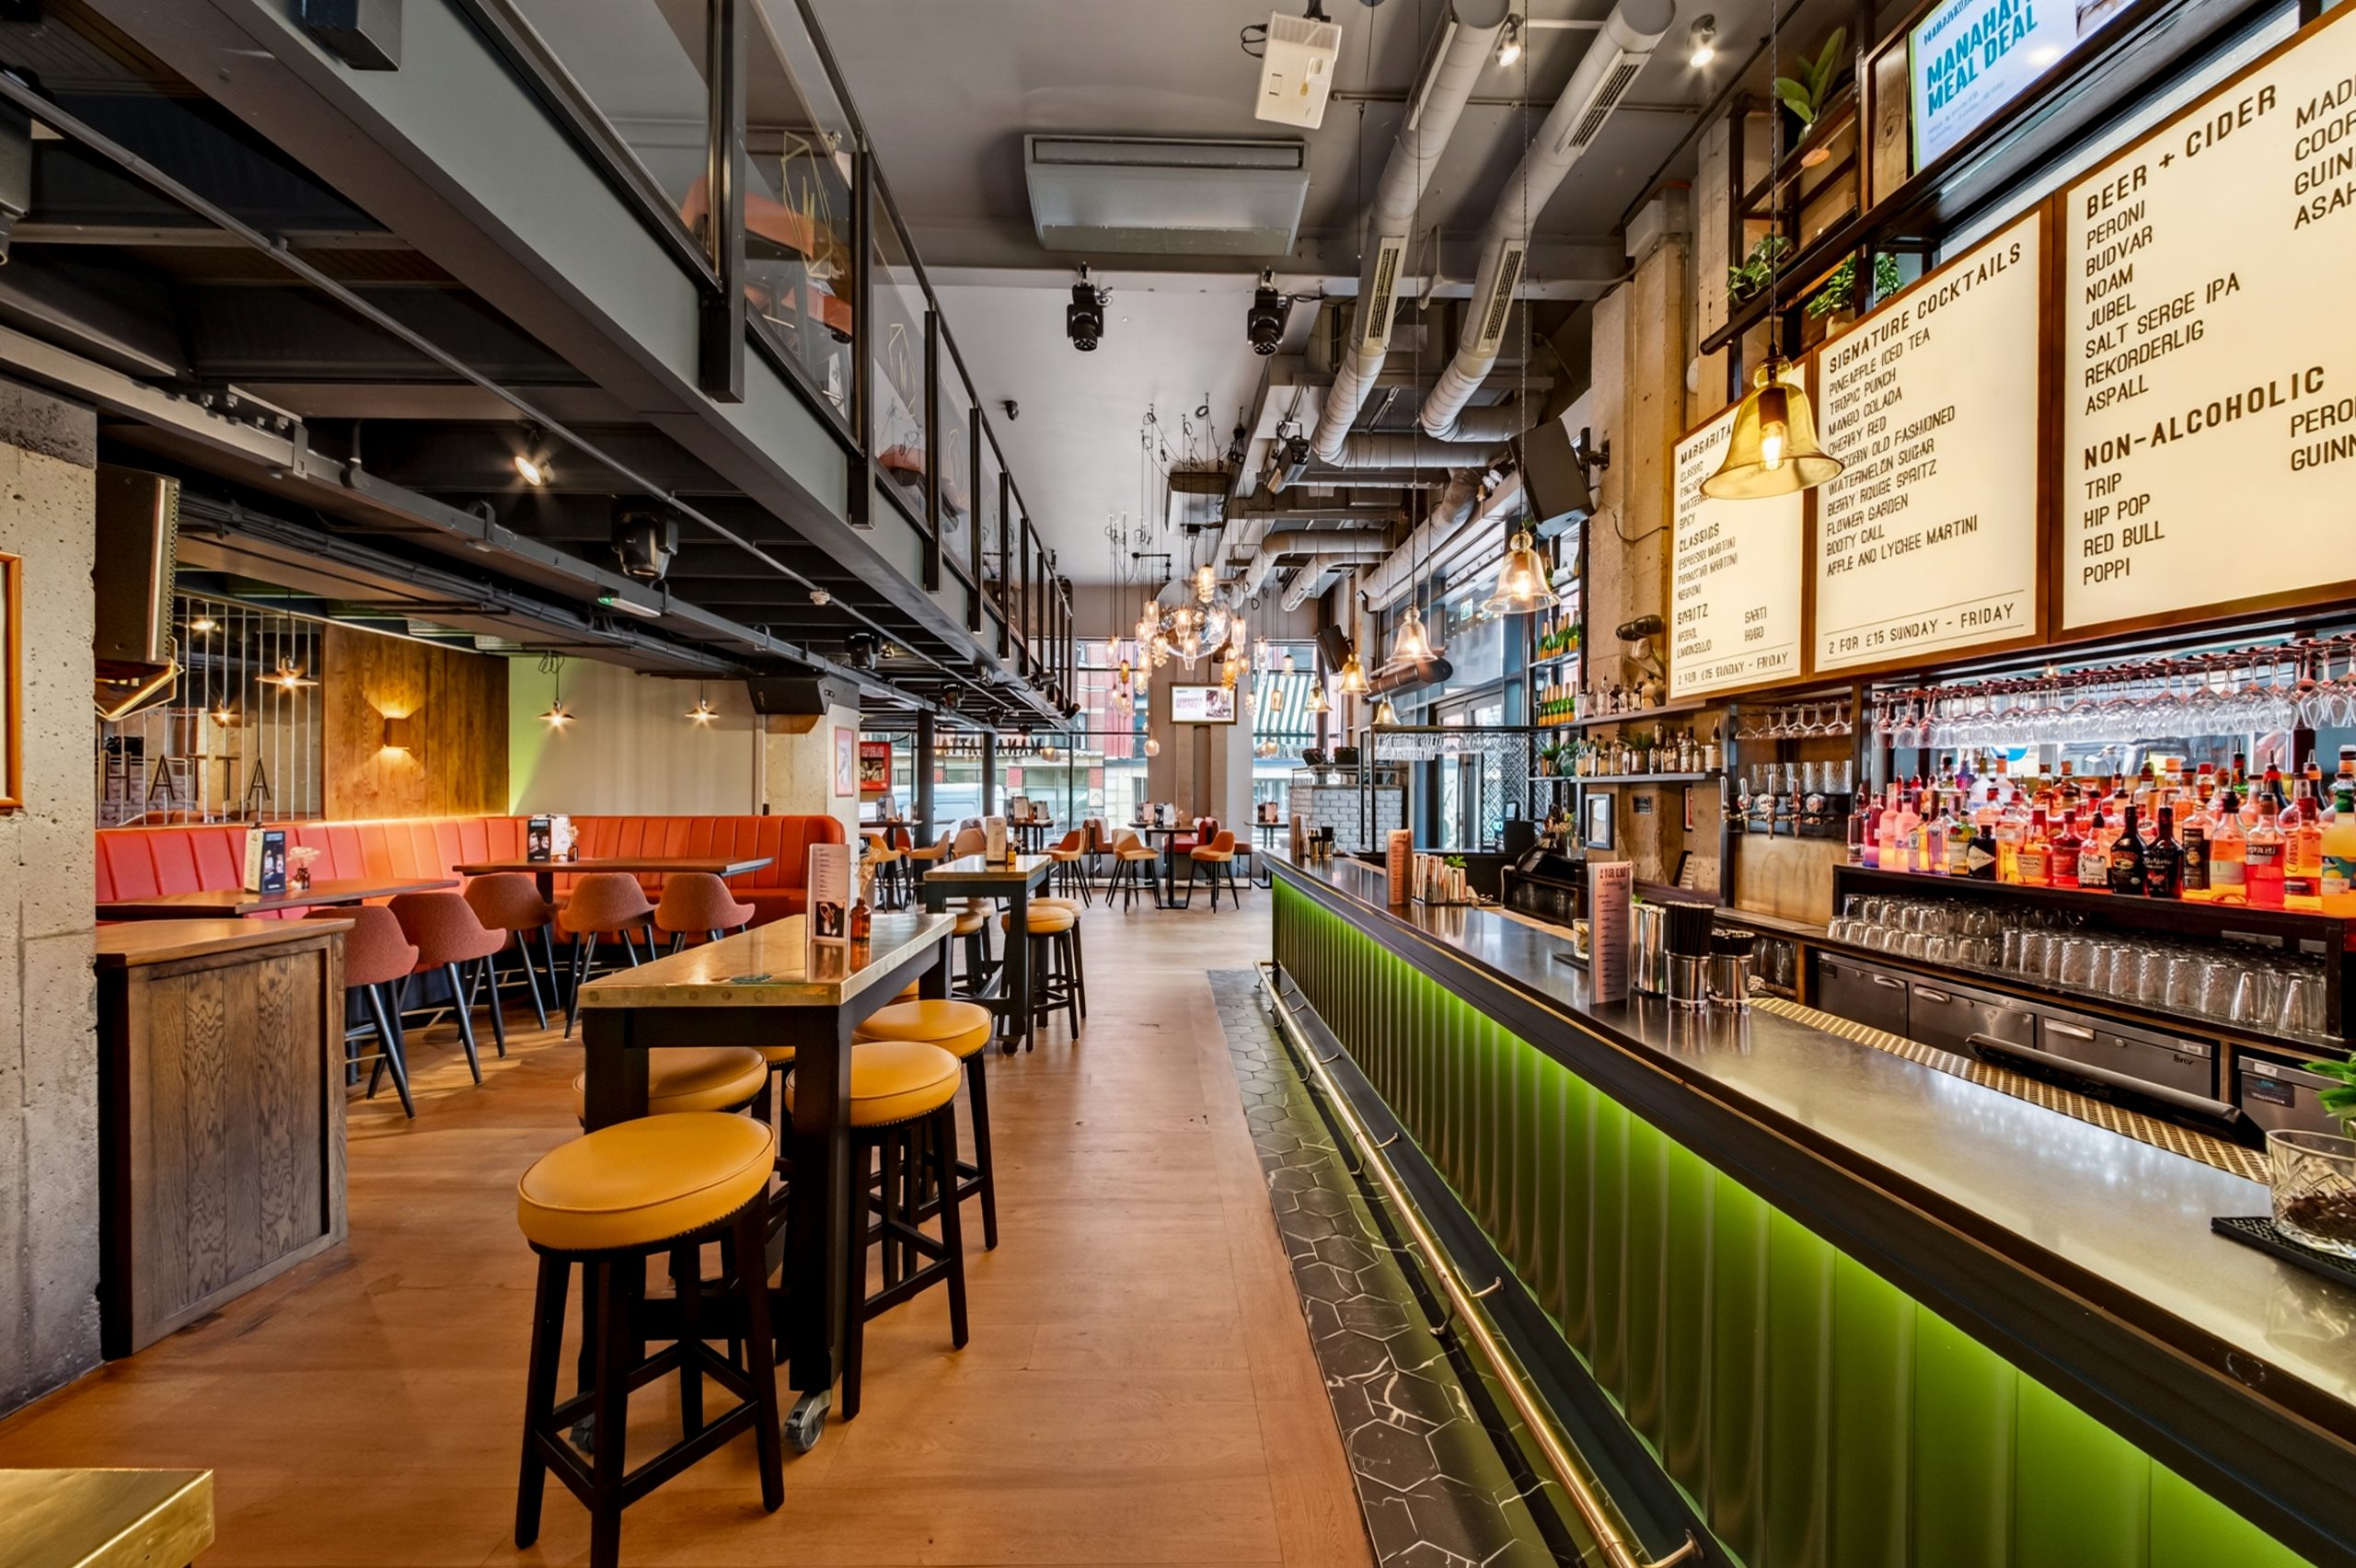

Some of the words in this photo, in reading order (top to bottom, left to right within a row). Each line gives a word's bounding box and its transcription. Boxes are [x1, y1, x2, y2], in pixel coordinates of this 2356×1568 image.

[1928, 62, 1979, 117] MEAL
[1984, 5, 2038, 70] DEAL
[2296, 74, 2356, 129] MAD
[2086, 165, 2147, 220] BEER
[2158, 153, 2175, 168] +
[2186, 85, 2276, 157] CIDER
[2295, 146, 2356, 195] GUIN
[2086, 200, 2145, 250] PERONI
[2085, 225, 2153, 277] BUDVAR
[2085, 263, 2133, 305] NOAM
[1830, 310, 1910, 374] SIGNATURE
[1918, 242, 2021, 319] COCKTAILS
[2085, 323, 2129, 359] SALT
[2137, 291, 2195, 335] SERGE
[2206, 271, 2240, 305] IPA
[2086, 294, 2136, 331] JUBEL
[1829, 357, 1876, 397] PINEAPPLE
[1881, 342, 1902, 366] ICED
[1909, 327, 1930, 351] TEA
[2085, 319, 2204, 387] REKORDERLIG
[1864, 367, 1896, 398] PUNCH
[1864, 386, 1902, 419] COLADA
[2085, 375, 2149, 415] ASPALL
[1867, 416, 1887, 437] RED
[1872, 435, 1889, 456] OLD
[1894, 405, 1955, 446] FASHIONED
[2085, 366, 2324, 470] NON-ALCOHOLIC
[2291, 395, 2356, 438] PERO
[1828, 455, 1894, 496] WATERMELON
[1898, 438, 1934, 466] SUGAR
[1828, 492, 1855, 517] BERRY
[1860, 477, 1891, 502] ROUGE
[1897, 459, 1936, 488] SPRITZ
[2085, 473, 2122, 500] TRIP
[1827, 511, 1864, 537] FLOWER
[1867, 493, 1908, 522] GARDEN
[2084, 506, 2109, 529] HIP
[2118, 493, 2150, 520] POP
[1679, 523, 1719, 553] CLASSICS
[1827, 533, 1856, 557] BOOTY
[1861, 525, 1885, 545] CALL
[1827, 555, 1854, 577] APPLE
[1857, 548, 1877, 567] AND
[1881, 533, 1922, 559] LYCHEE
[1926, 514, 1978, 545] MARTINI
[2084, 533, 2114, 558] RED
[2122, 520, 2165, 548] BULL
[2084, 558, 2131, 585] POPPI
[1678, 603, 1708, 625] SPRITZ
[1829, 641, 1834, 654] 2
[1840, 636, 1859, 651] FOR
[1866, 629, 1884, 647] £15
[1890, 618, 1938, 641] SUNDAY
[1960, 603, 2014, 628] FRIDAY
[1757, 652, 1788, 670] FRIDAY
